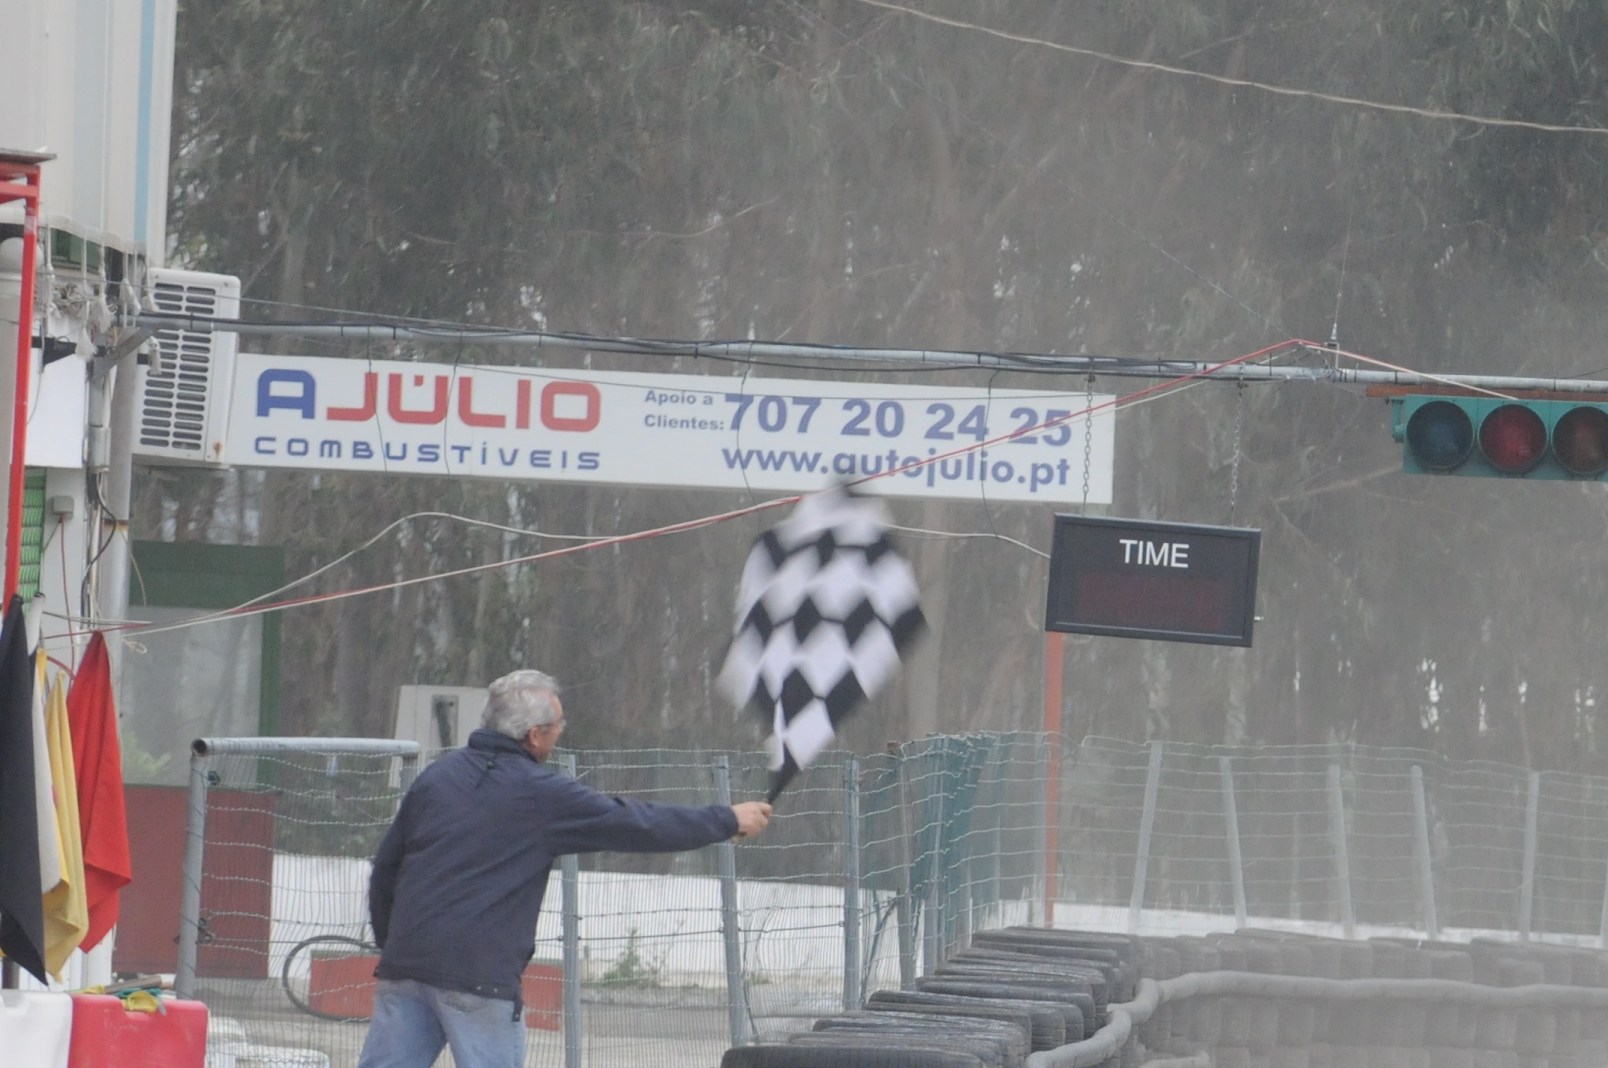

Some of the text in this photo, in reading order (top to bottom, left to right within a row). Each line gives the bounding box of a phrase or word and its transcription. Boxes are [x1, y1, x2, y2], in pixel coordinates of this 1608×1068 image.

[645, 389, 714, 407] Apoio a
[643, 413, 726, 431] Clientes:
[724, 392, 1073, 448] 707 20 24 25
[254, 435, 601, 471] COMBUSTÍVEIS
[721, 446, 1072, 493] www.autojulio.pt
[1119, 538, 1190, 569] TIME
